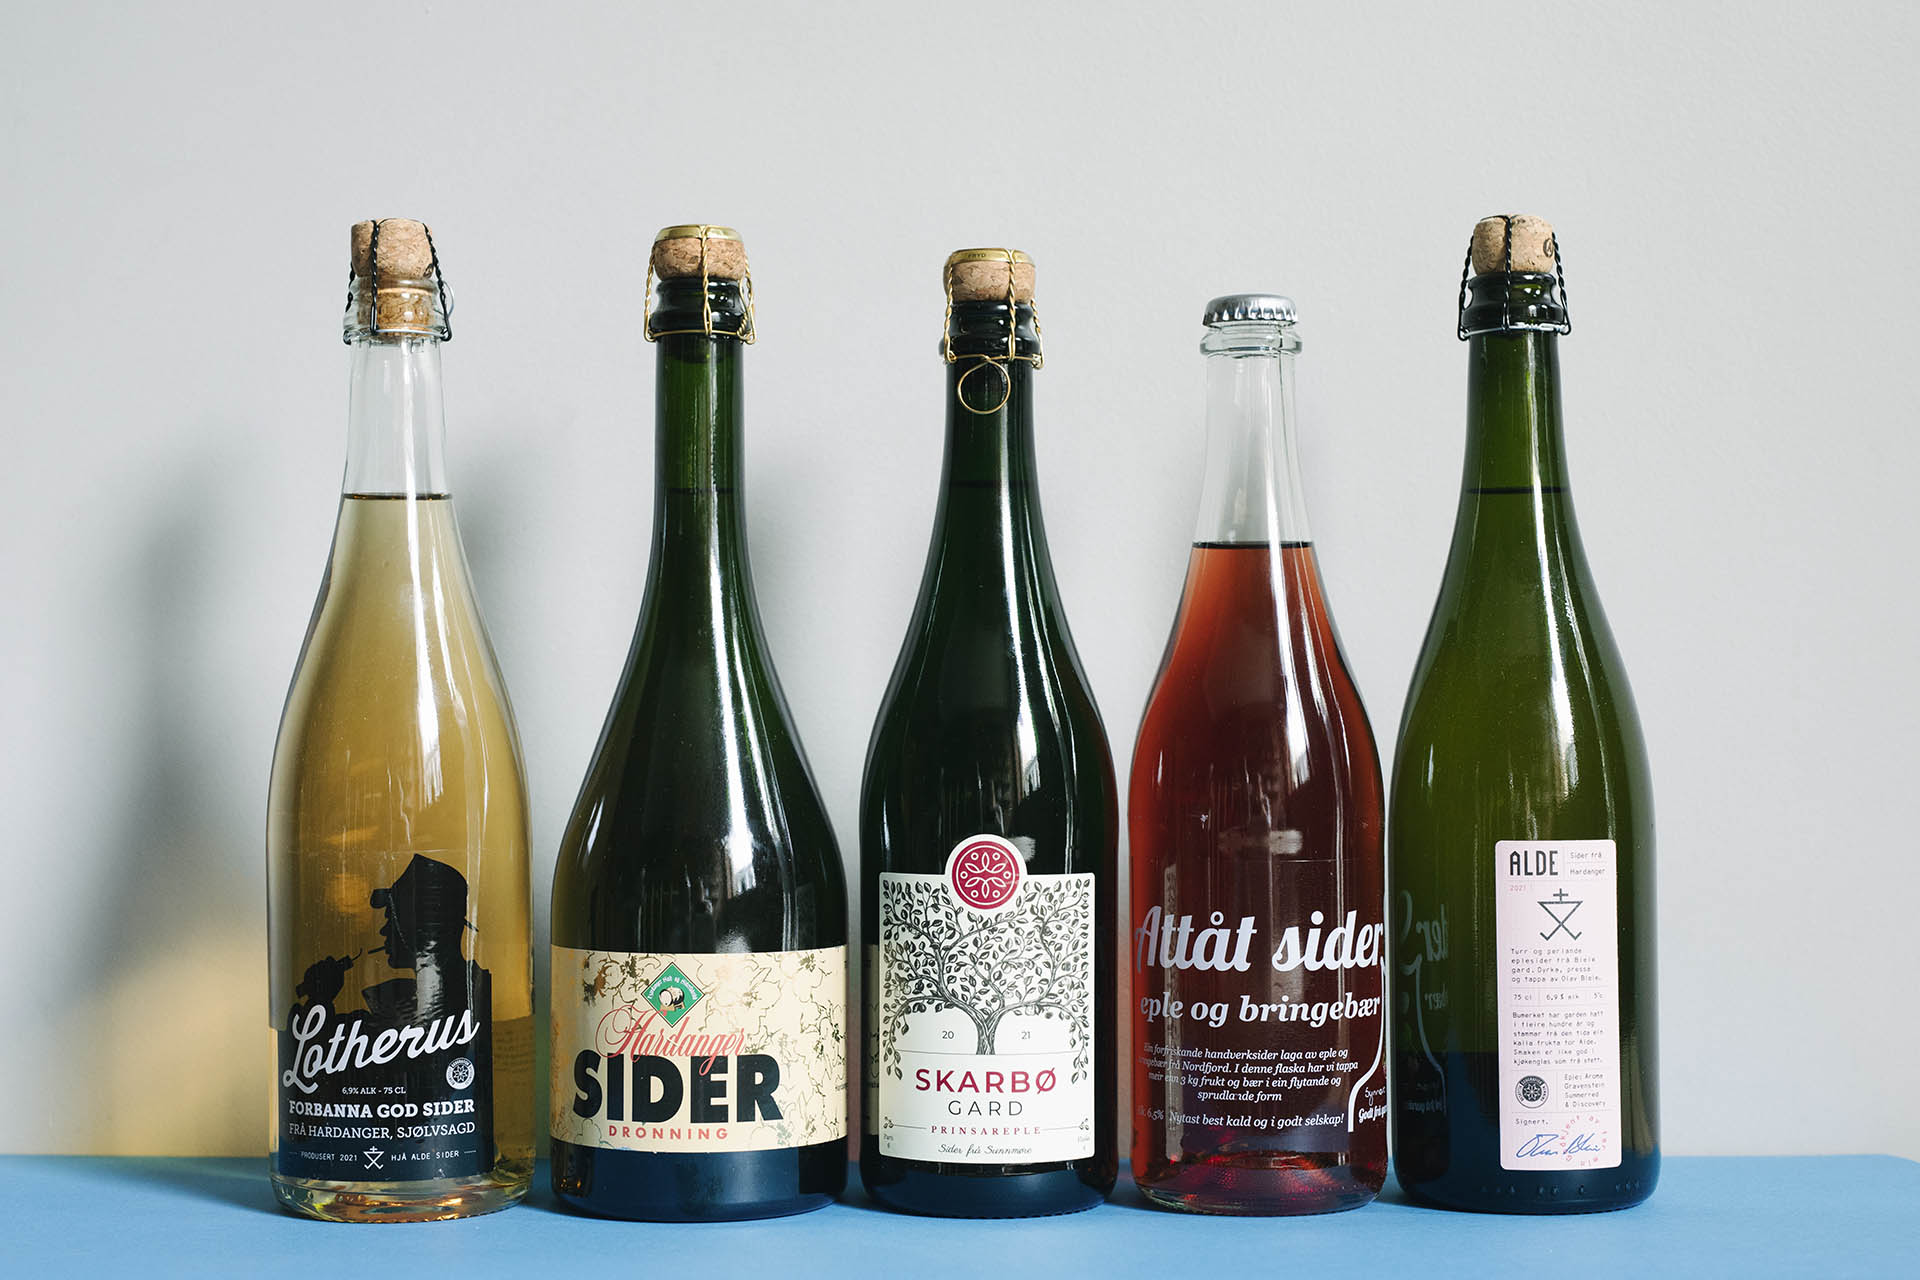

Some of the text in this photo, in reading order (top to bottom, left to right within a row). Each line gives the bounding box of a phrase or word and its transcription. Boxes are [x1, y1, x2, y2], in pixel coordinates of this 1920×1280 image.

[1510, 850, 1558, 876] ALDE
[1135, 905, 1383, 974] Attåt sider
[1140, 992, 1380, 1028] eple og bringebær
[594, 1004, 745, 1076] Hardanger
[942, 1030, 1031, 1040] 20 21
[282, 1004, 480, 1094] Lotherus
[1205, 1048, 1278, 1060] handverksider
[1280, 1050, 1302, 1062] laga
[1319, 1048, 1337, 1060] eple
[1338, 1049, 1348, 1060] og
[1167, 1058, 1180, 1070] frå
[1182, 1061, 1232, 1074] Nordfjord.
[1234, 1064, 1240, 1073] I
[1241, 1064, 1272, 1074] denne
[1273, 1064, 1305, 1075] flaska
[1307, 1063, 1324, 1072] har
[1325, 1062, 1334, 1072] vi
[1336, 1062, 1358, 1072] tappa
[572, 1050, 784, 1124] SIDER
[915, 1067, 1056, 1094] SKARBØ
[1187, 1075, 1199, 1087] kg
[1199, 1076, 1225, 1088] frukt
[1227, 1080, 1240, 1089] og
[1242, 1077, 1264, 1087] bær
[1265, 1078, 1270, 1087] i
[1272, 1078, 1288, 1087] ein
[1288, 1076, 1329, 1089] flytande
[1330, 1077, 1341, 1088] og
[1255, 1091, 1282, 1103] form
[289, 1099, 475, 1118] FORBANNA GOD SIDER
[948, 1100, 1023, 1116] GARD
[1170, 1111, 1200, 1125] Nytast
[1202, 1114, 1224, 1126] best
[1226, 1115, 1251, 1127] kald
[1254, 1118, 1268, 1129] og
[1271, 1116, 1276, 1127] i
[1277, 1116, 1302, 1130] godt
[1304, 1113, 1344, 1127] selskap!
[289, 1121, 475, 1140] FRÅ HARDANGER, SJØLVSAGD
[608, 1124, 728, 1140] DRONNING
[931, 1126, 1040, 1135] PRINSAREPLE
[301, 1151, 334, 1160] PRODUSERT
[391, 1152, 407, 1161] HJÅ
[436, 1150, 459, 1159] SIDER
[938, 1144, 962, 1154] Sider
[966, 1144, 981, 1157] frå
